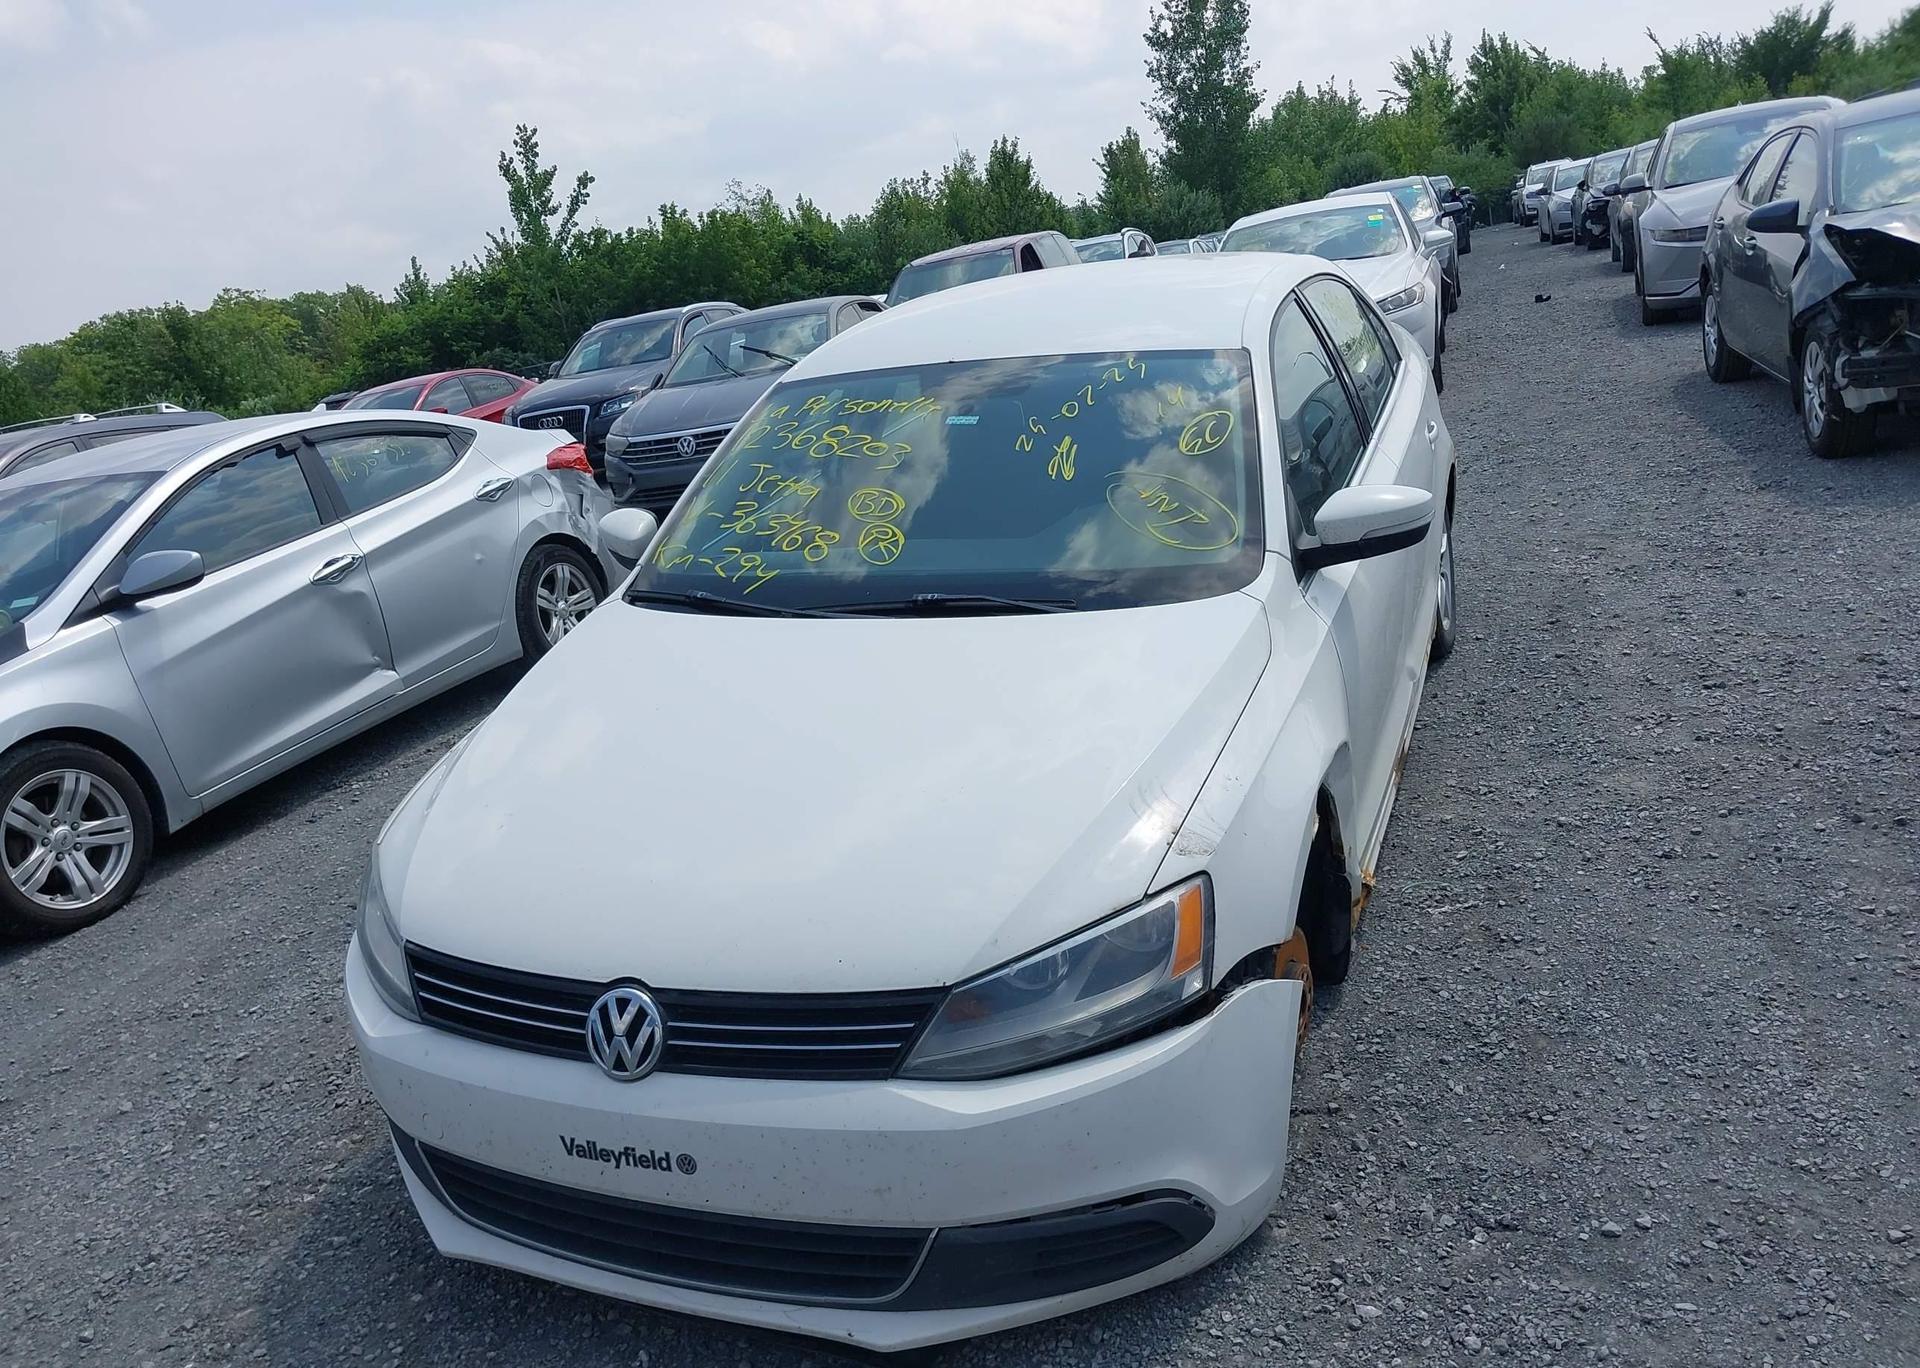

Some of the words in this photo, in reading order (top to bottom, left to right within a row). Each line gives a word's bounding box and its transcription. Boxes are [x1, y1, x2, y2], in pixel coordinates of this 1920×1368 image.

[677, 436, 696, 457] VW
[739, 463, 821, 508] Jetta
[852, 489, 902, 518] BD
[587, 988, 662, 1080] VW
[559, 1135, 673, 1172] Valleyfield
